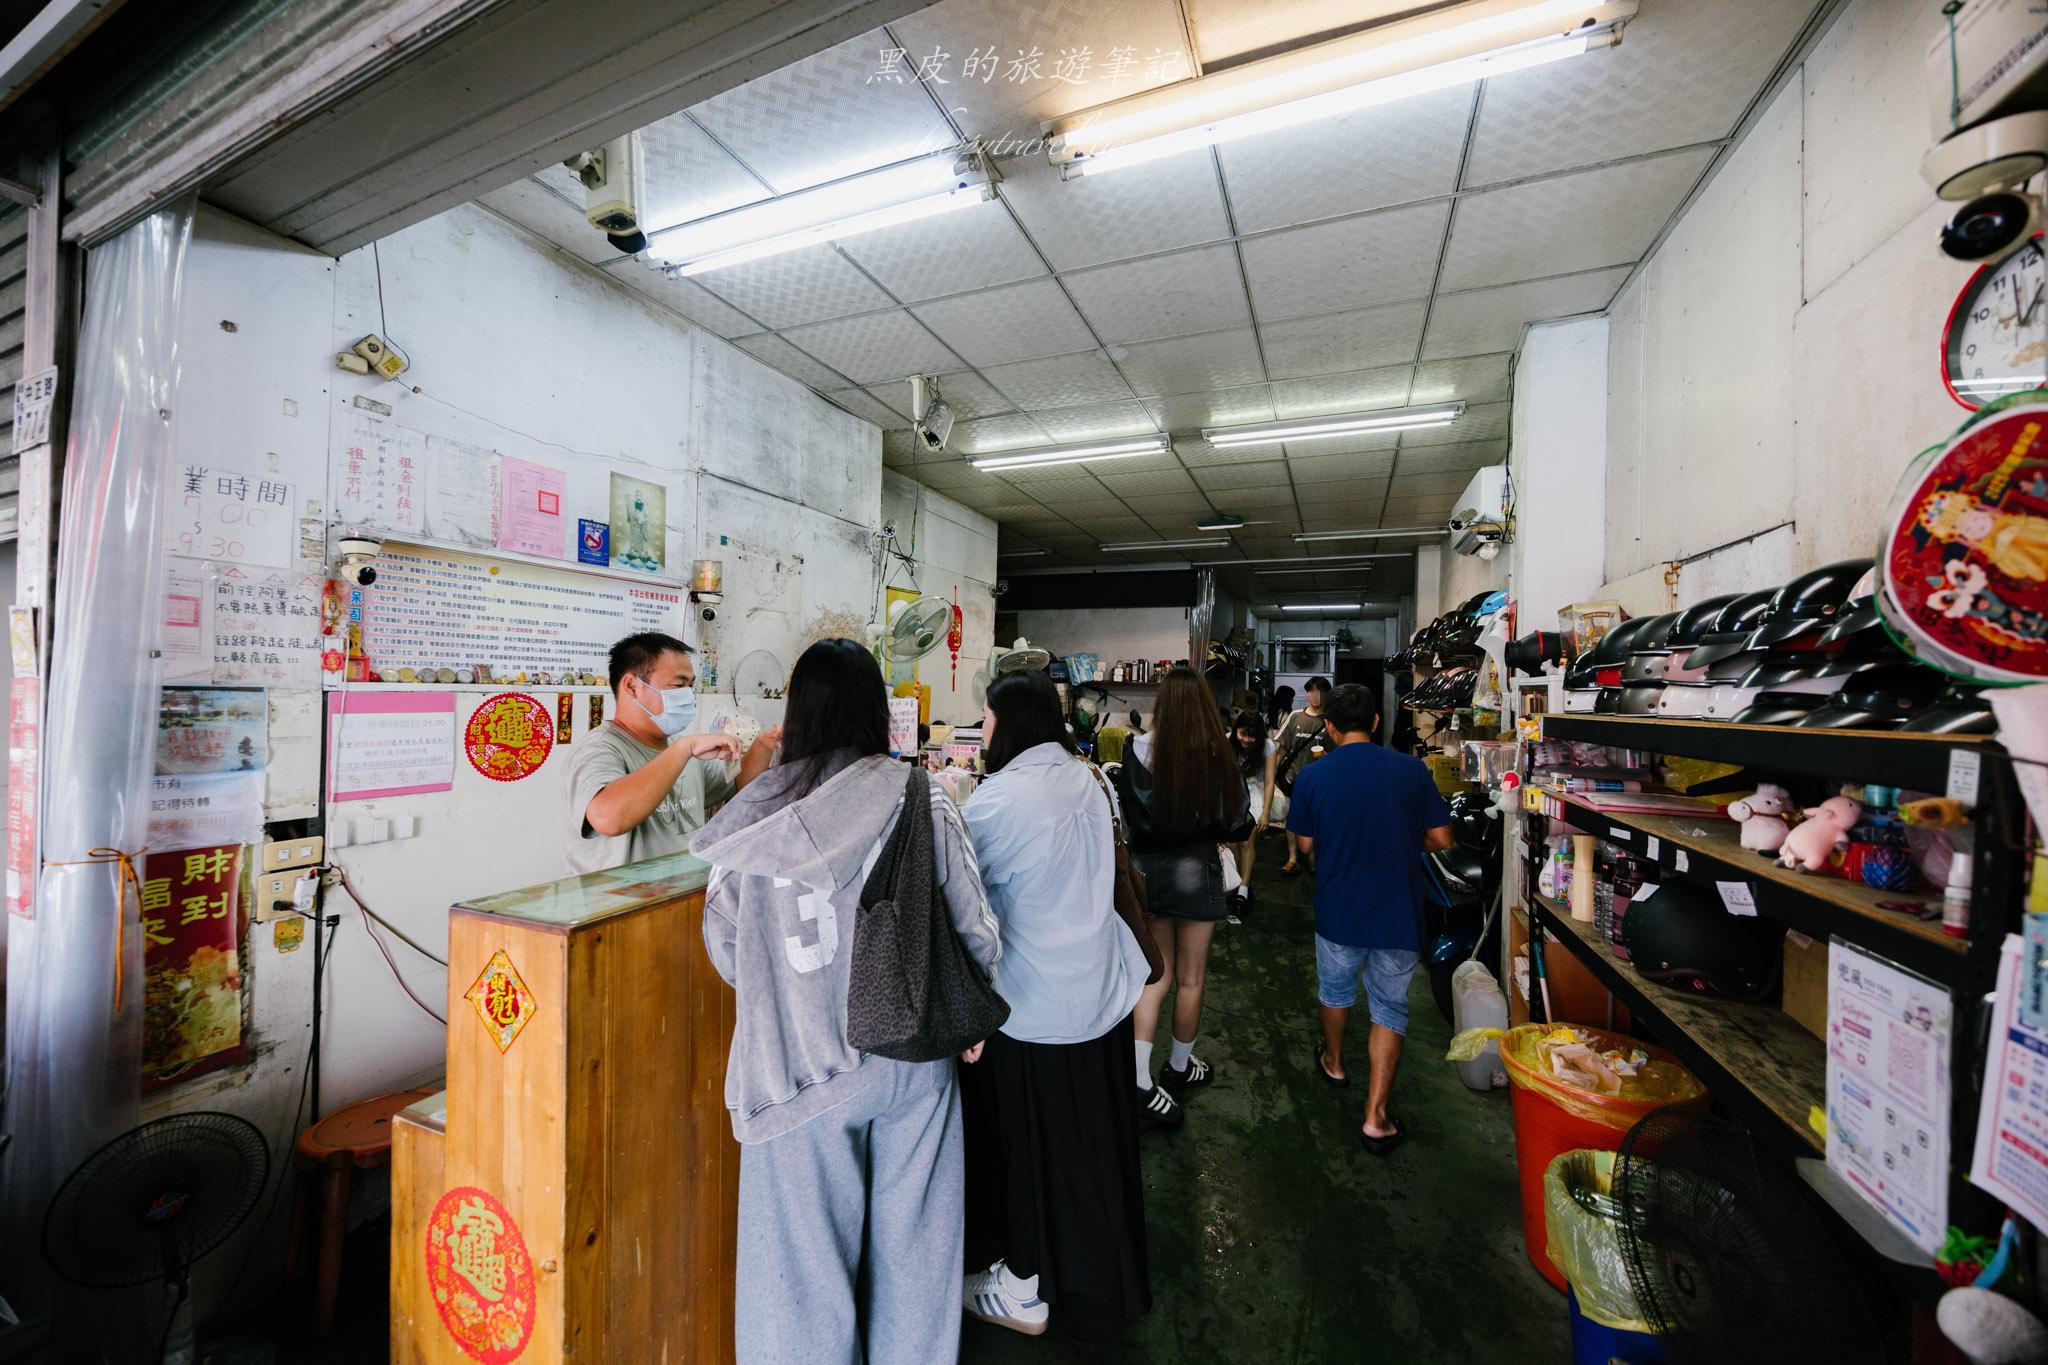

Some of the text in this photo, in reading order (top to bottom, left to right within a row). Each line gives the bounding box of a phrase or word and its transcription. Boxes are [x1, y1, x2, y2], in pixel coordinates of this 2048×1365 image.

[2020, 253, 2039, 270] 12
[1993, 276, 2007, 292] 11
[1973, 308, 1990, 324] 10
[184, 465, 288, 505] 業時間
